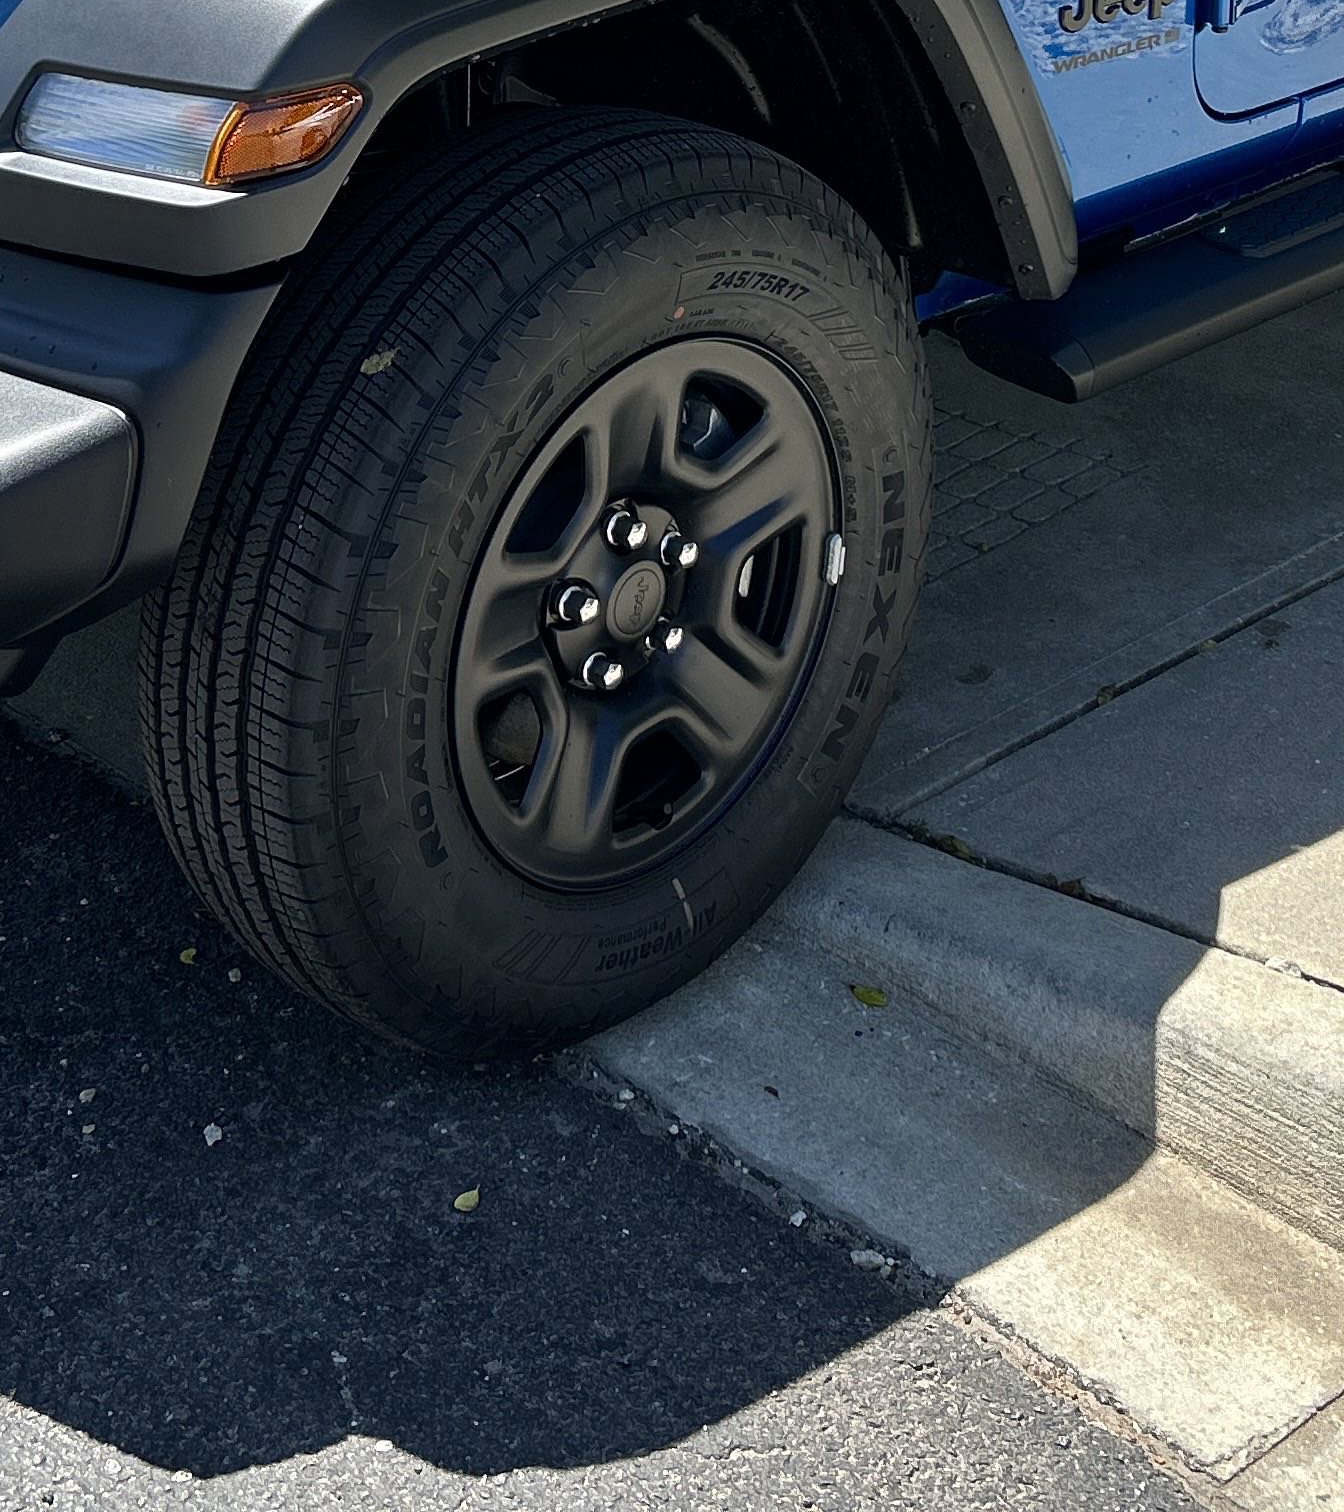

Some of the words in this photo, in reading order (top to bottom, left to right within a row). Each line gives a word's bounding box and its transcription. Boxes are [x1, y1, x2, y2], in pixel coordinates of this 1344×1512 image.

[1052, 34, 1161, 74] WRANGLER
[707, 271, 810, 302] 245/75R17
[821, 471, 905, 762] NEXEN
[405, 567, 451, 869] ROADIAN
[595, 901, 717, 972] All-Weather
